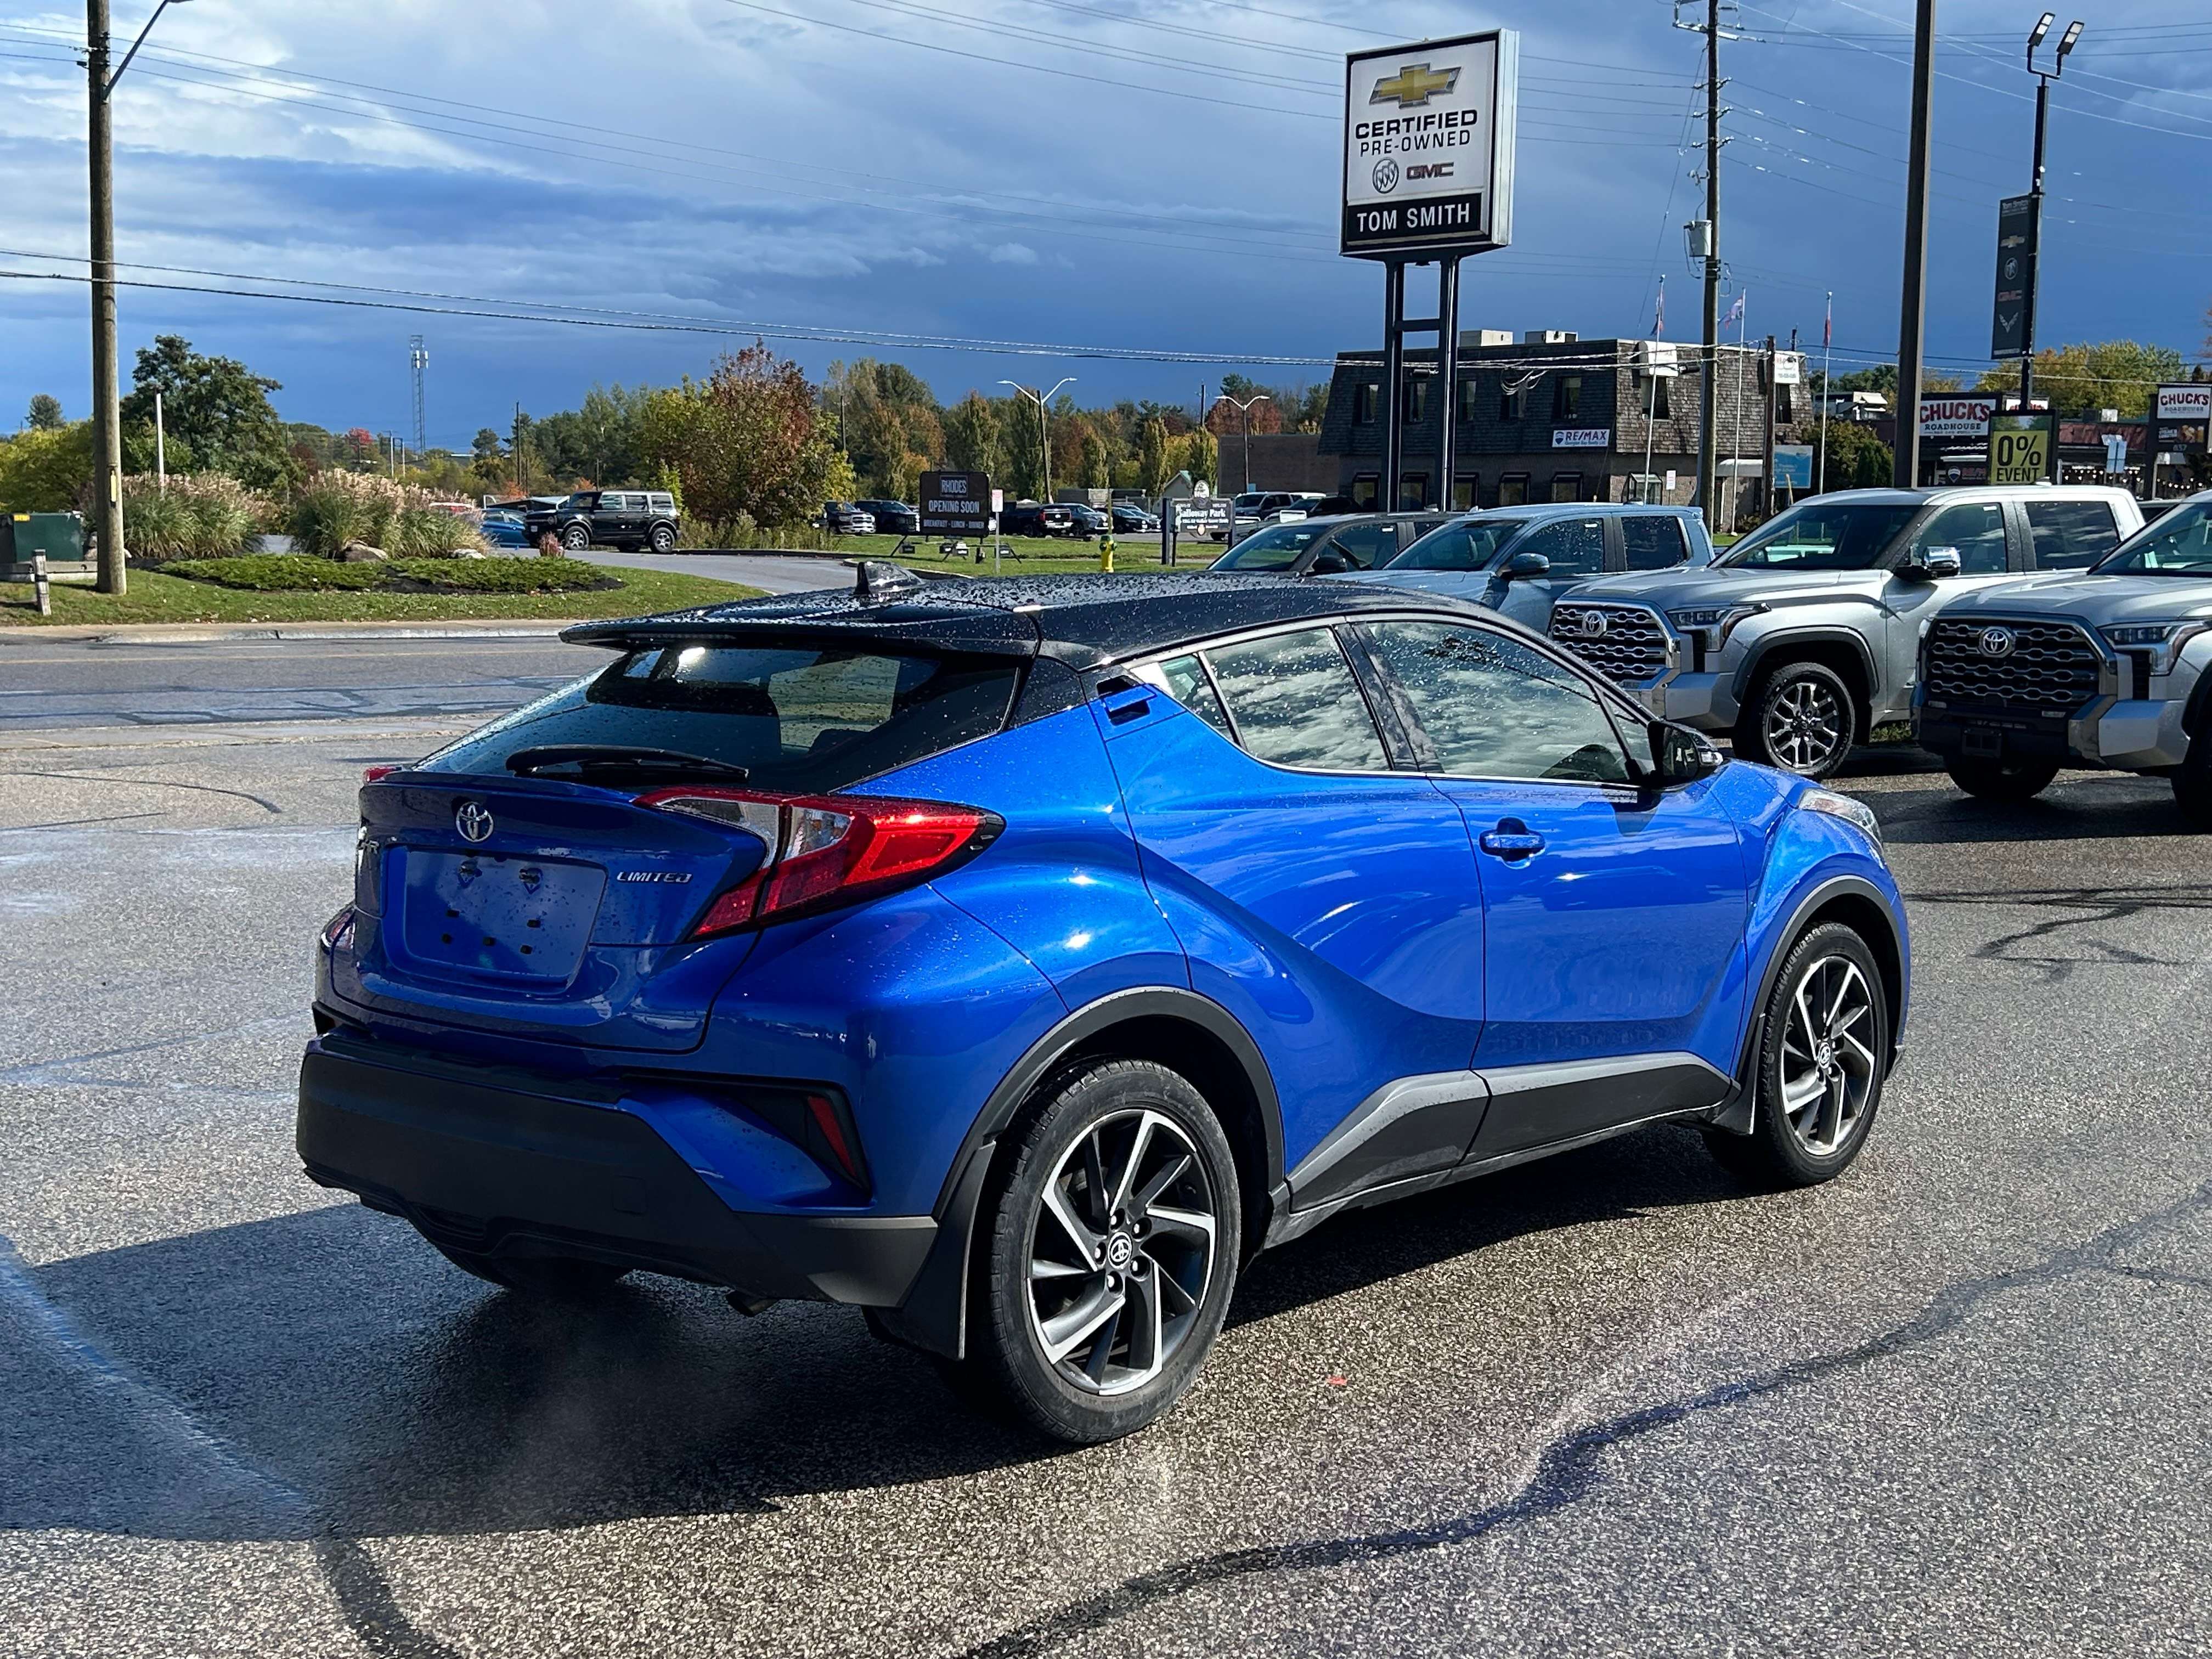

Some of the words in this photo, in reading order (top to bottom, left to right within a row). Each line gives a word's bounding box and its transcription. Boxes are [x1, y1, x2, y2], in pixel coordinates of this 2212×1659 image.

[1355, 109, 1478, 139] CERTIFIED
[1360, 129, 1470, 157] PRE-OWNED
[1406, 162, 1454, 180] GMC
[1357, 210, 1397, 232] TOM
[1407, 203, 1470, 228] SMITH
[2160, 393, 2210, 405] CHUCK'S
[1920, 402, 1990, 423] CHUCK'S
[1565, 430, 1607, 441] RE/MAX
[1997, 435, 2041, 467] 0%
[1996, 467, 2040, 482] EVENT
[941, 479, 967, 494] RHODES
[928, 500, 959, 514] OPENING
[960, 500, 980, 514] SOON
[616, 871, 692, 883] LIMITED
